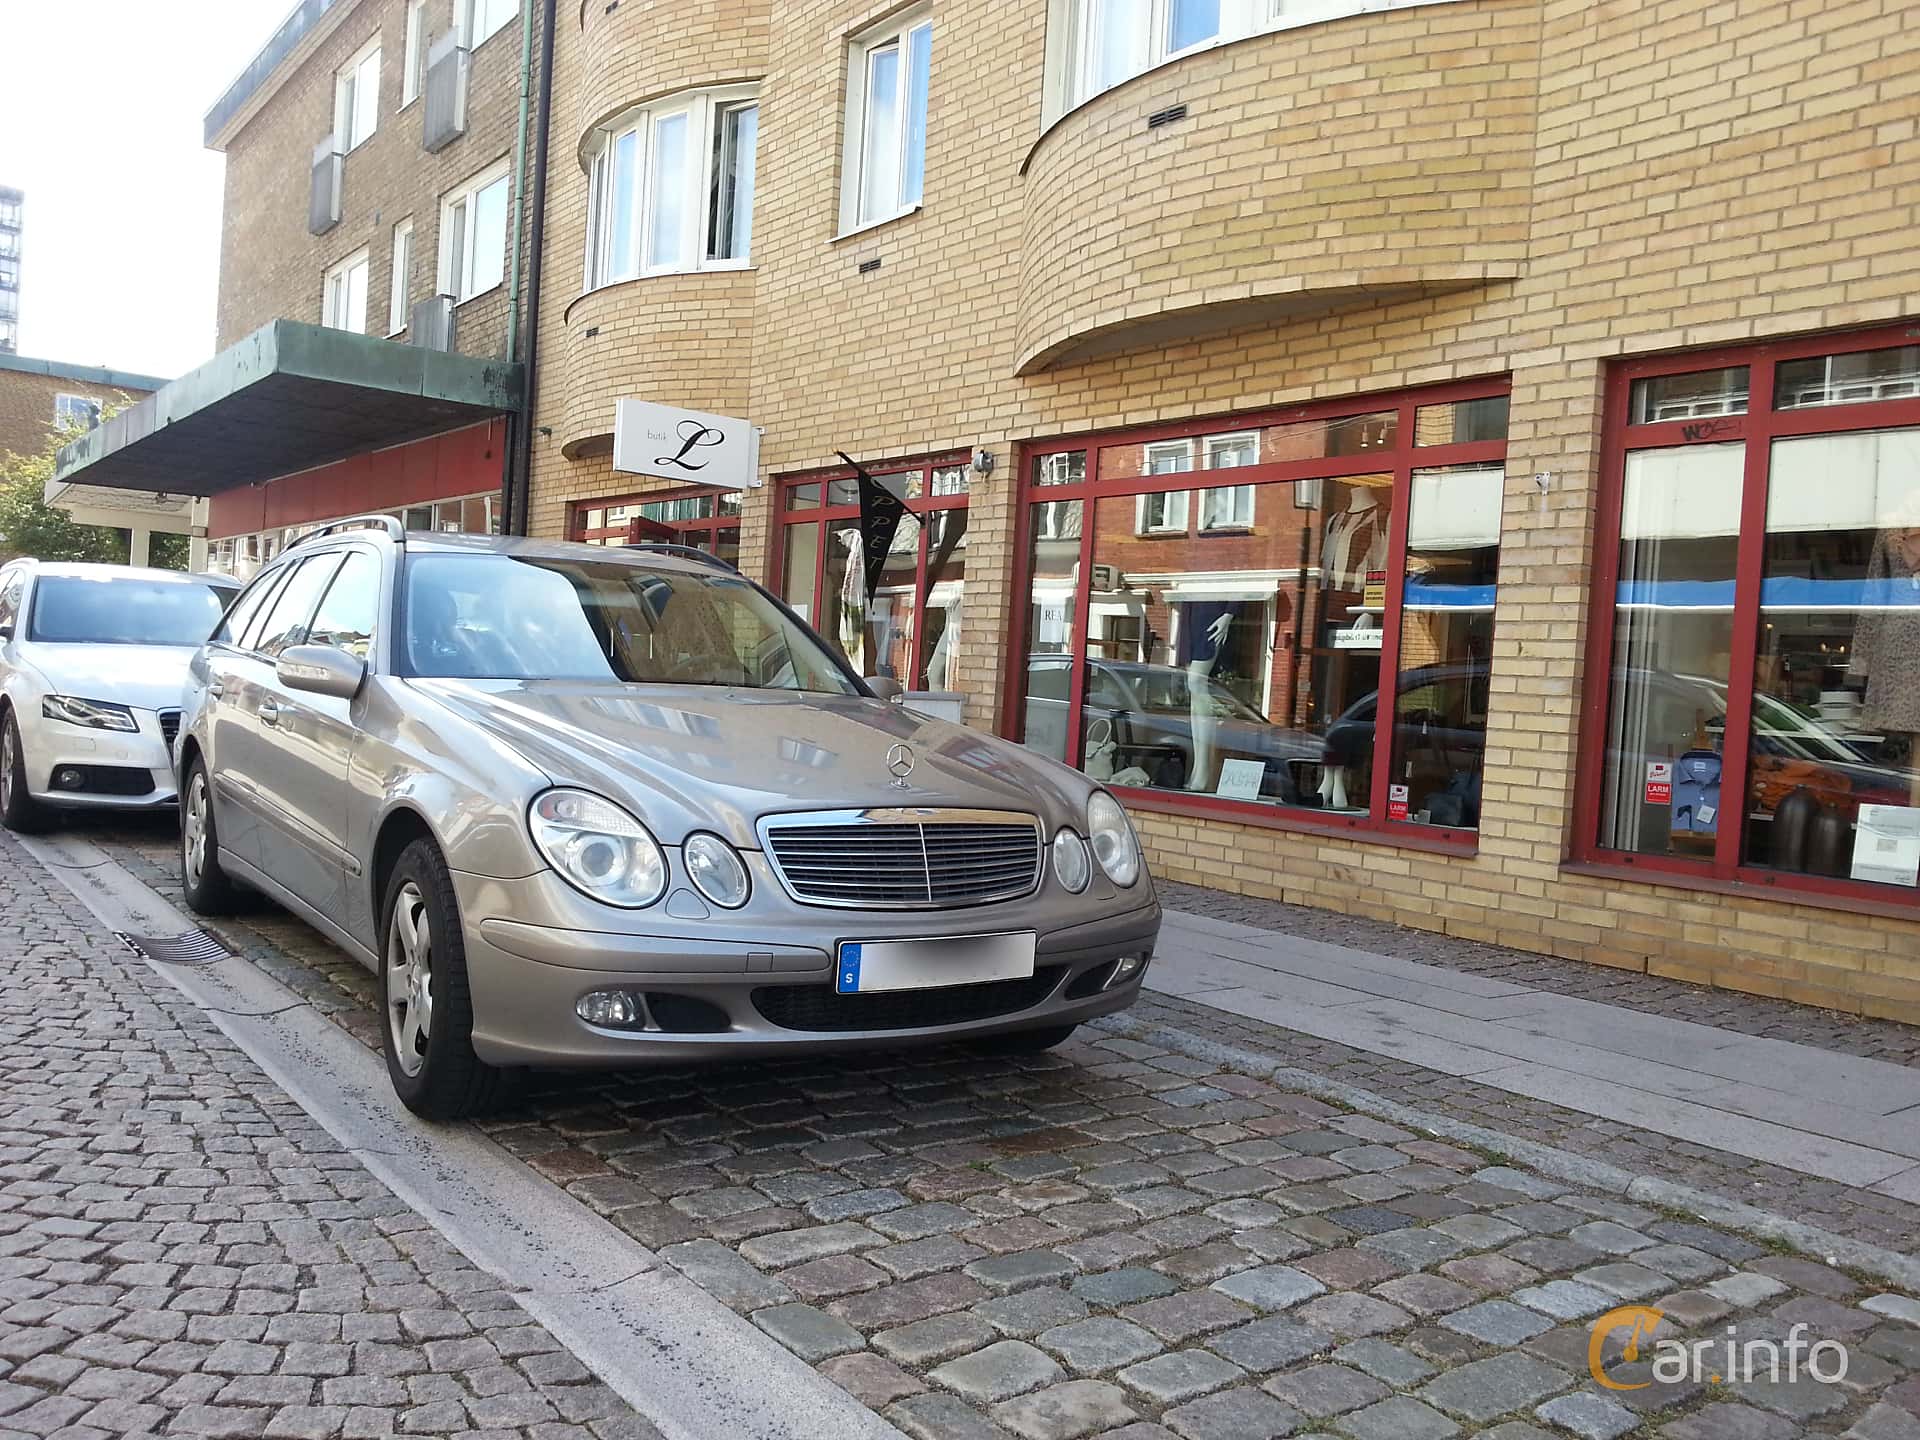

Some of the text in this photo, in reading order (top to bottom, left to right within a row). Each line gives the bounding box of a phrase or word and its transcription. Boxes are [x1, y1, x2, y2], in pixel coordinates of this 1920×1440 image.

[647, 429, 667, 441] butik
[1647, 785, 1669, 793] LARM
[845, 972, 854, 984] S
